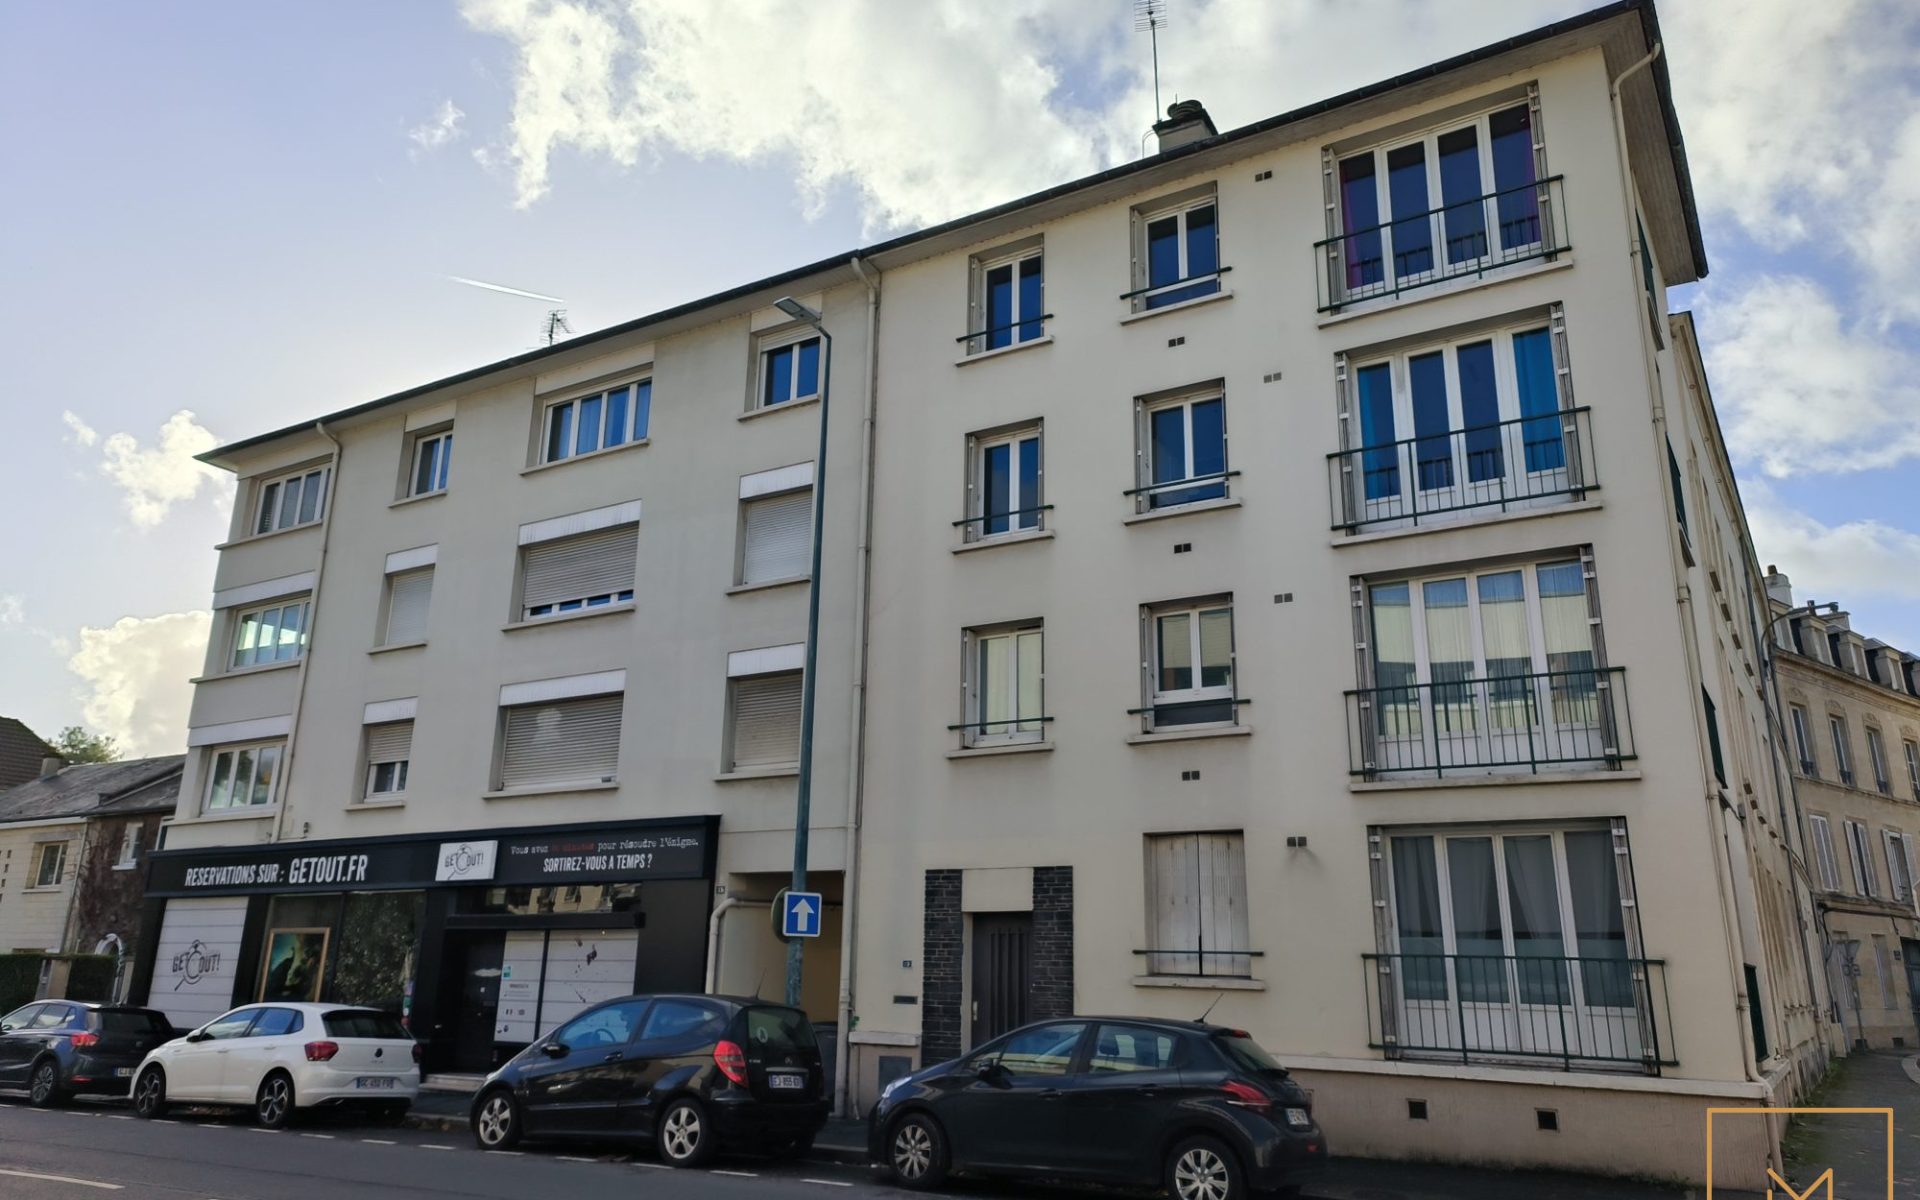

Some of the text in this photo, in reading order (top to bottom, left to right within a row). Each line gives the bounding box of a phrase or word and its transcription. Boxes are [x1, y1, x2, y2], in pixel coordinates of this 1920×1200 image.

[597, 842, 616, 852] pour
[620, 839, 657, 850] résoudre
[185, 864, 256, 886] RESERVATIONS
[289, 854, 368, 884] GETOUT.FR
[543, 855, 608, 873] SORTIREZ-VOUS
[616, 853, 646, 870] TEMPS
